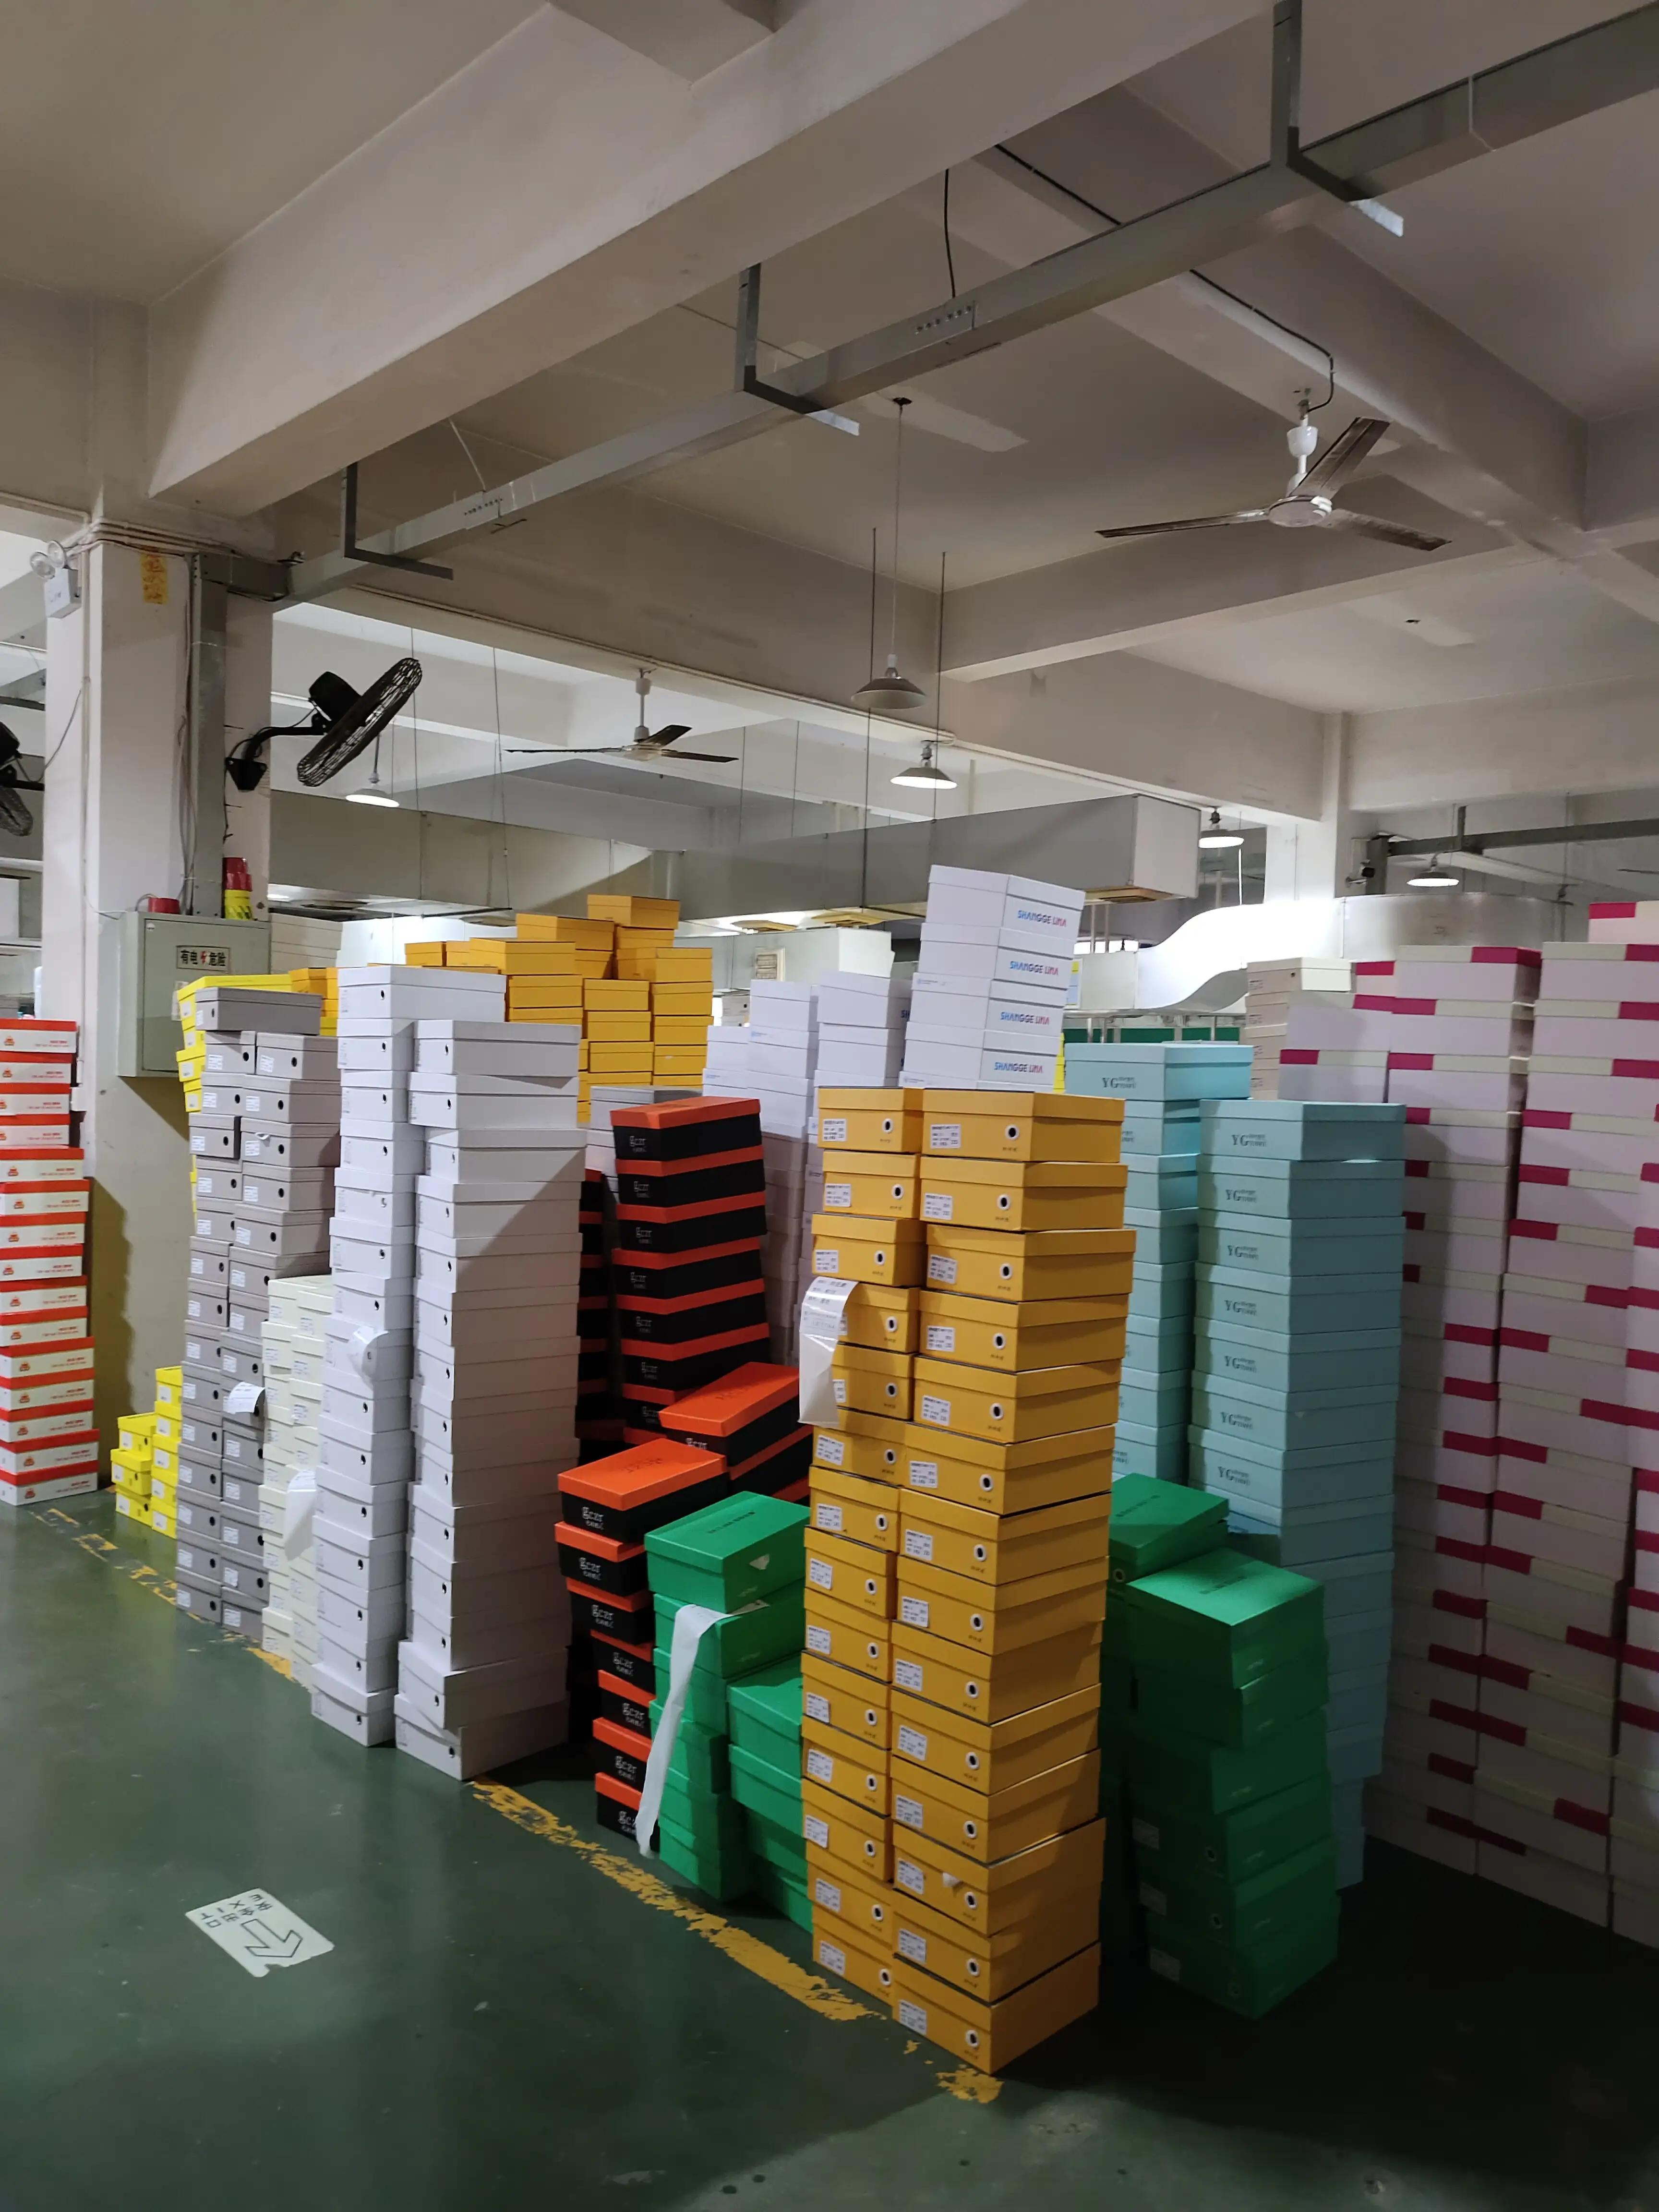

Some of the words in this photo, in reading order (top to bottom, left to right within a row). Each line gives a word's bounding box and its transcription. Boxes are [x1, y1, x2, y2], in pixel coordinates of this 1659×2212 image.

[201, 1894, 263, 1920] EXIT
[205, 1901, 273, 1928] 安全出口
